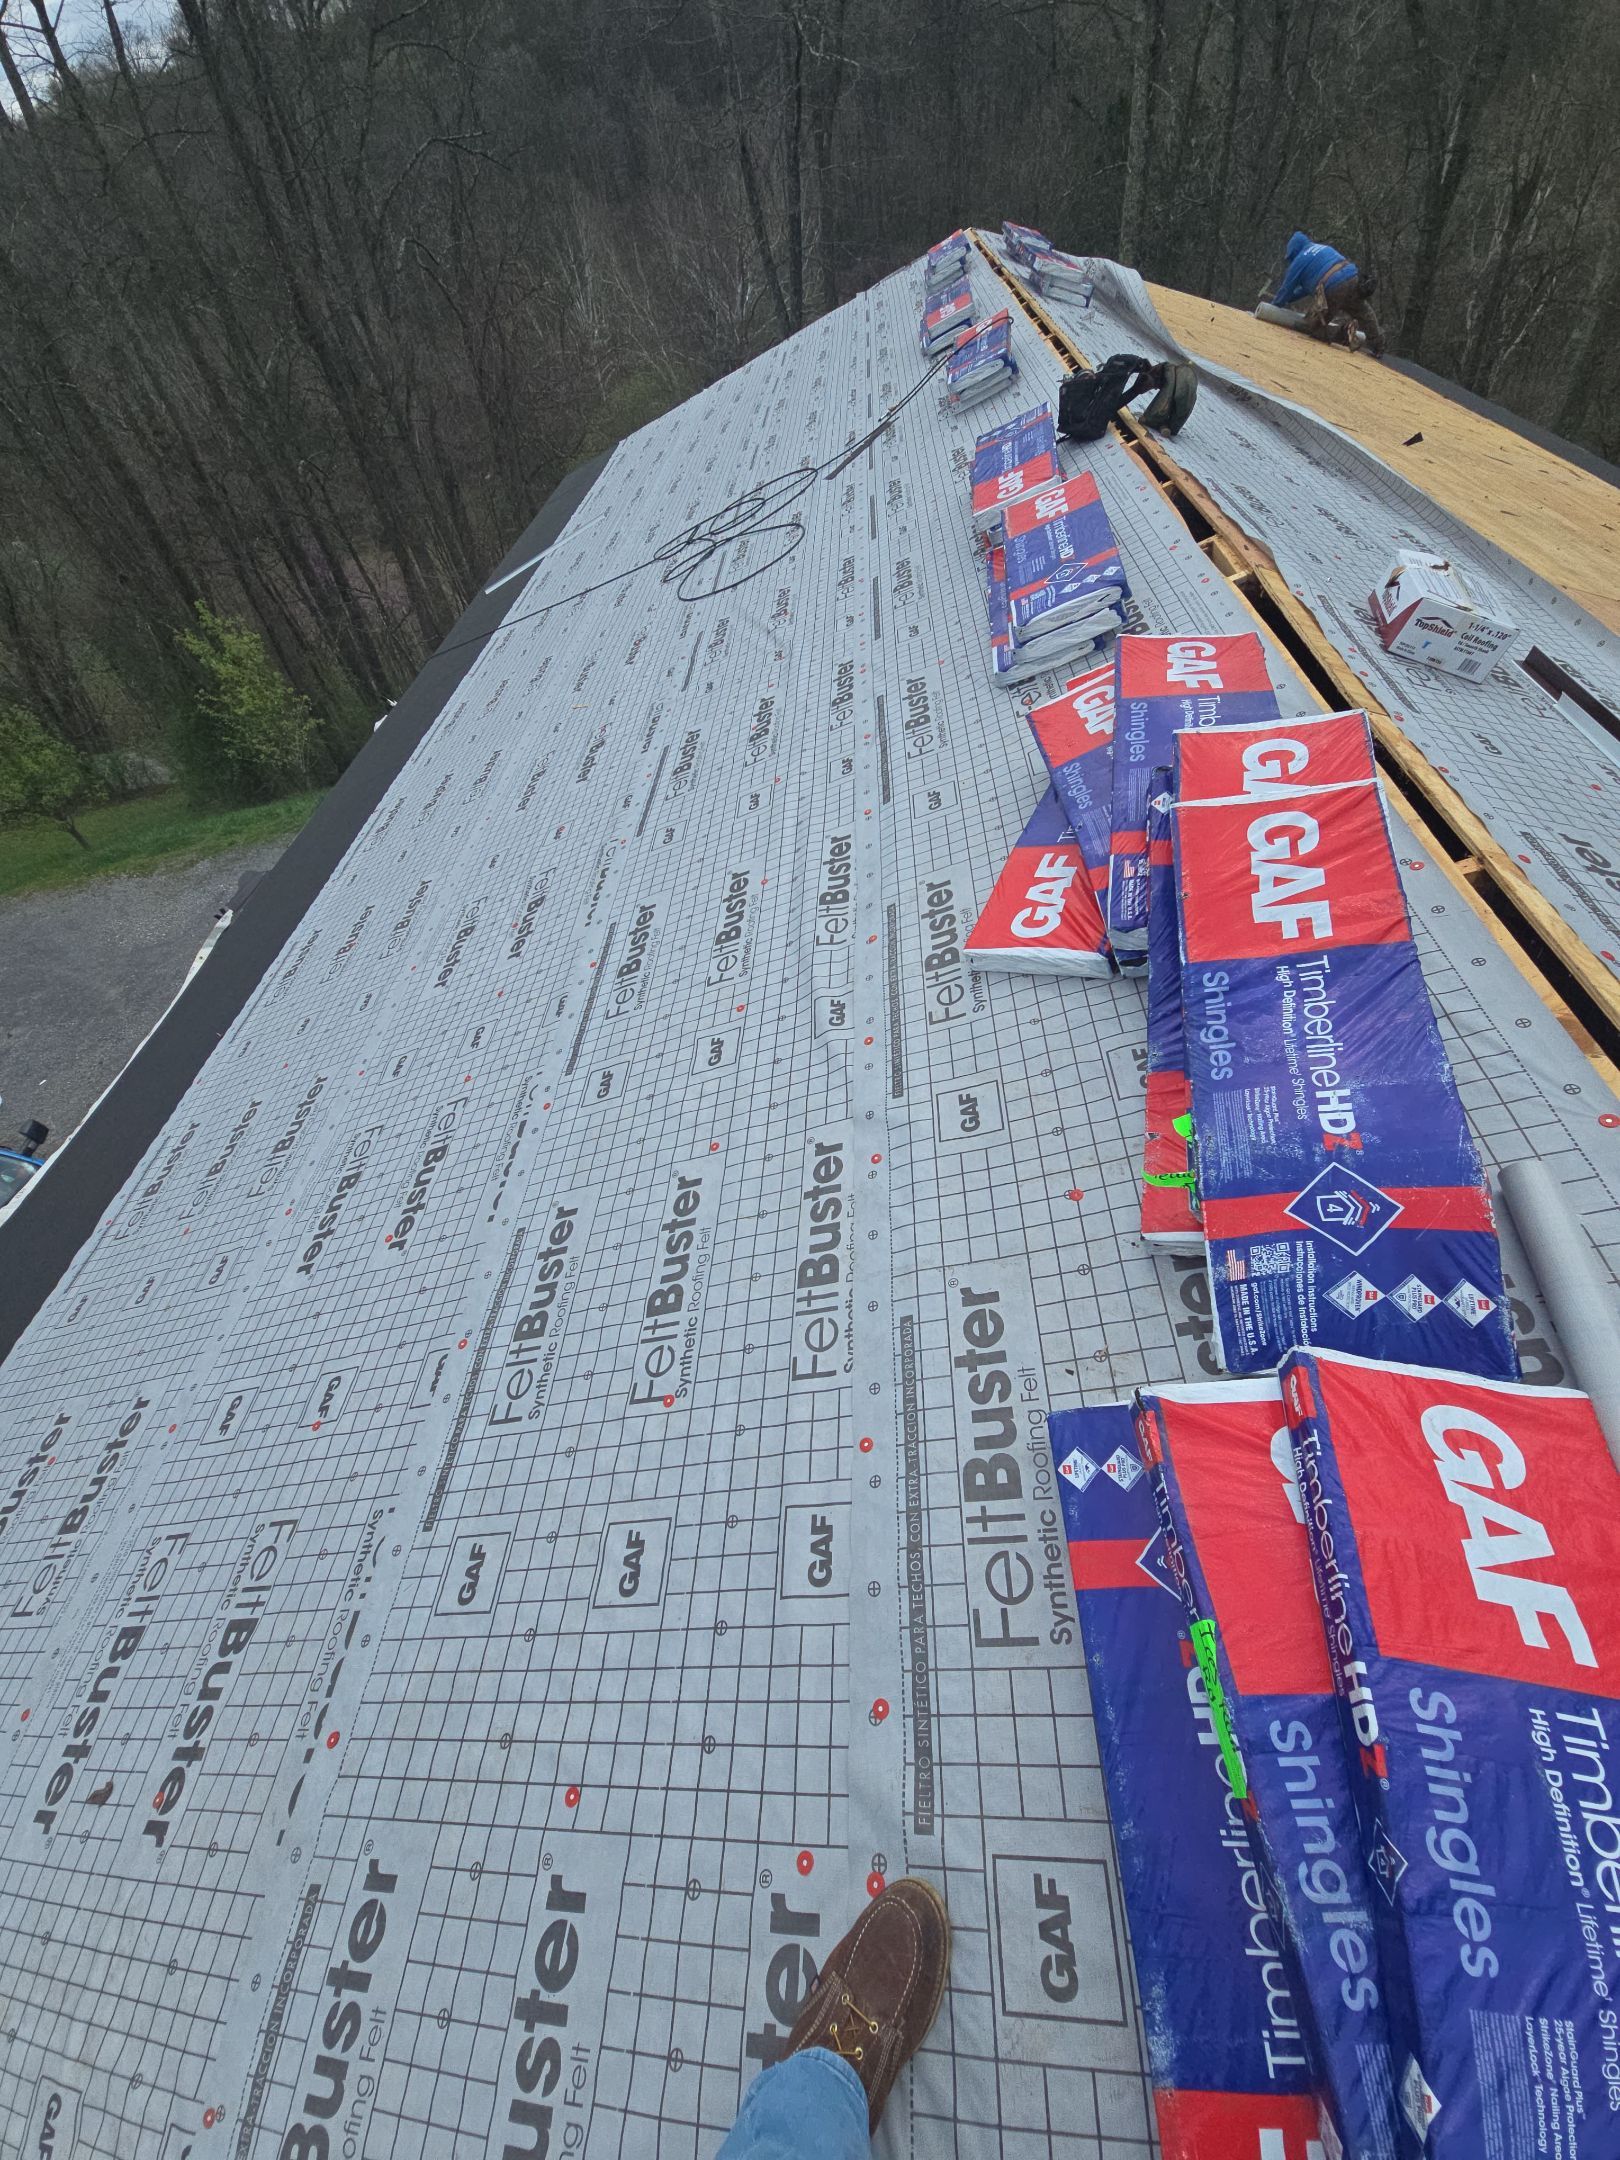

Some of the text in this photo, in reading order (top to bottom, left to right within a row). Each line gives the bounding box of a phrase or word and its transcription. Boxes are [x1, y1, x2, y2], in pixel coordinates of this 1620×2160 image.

[1035, 487, 1069, 520] GAF
[893, 557, 914, 610] FeltBuster
[908, 624, 919, 638] GAF
[1167, 641, 1224, 689] GAF
[1414, 618, 1454, 638] TopShield
[1461, 632, 1474, 643] Coil
[1473, 635, 1499, 652] Roofing
[745, 695, 776, 768] FeltBuster
[830, 659, 853, 732] FeltBuster
[902, 676, 935, 760] FeltBuster
[1125, 702, 1150, 762] Shingles
[665, 728, 703, 803] FeltBuster
[749, 792, 761, 811] GAF
[842, 757, 853, 776] GAF
[927, 790, 943, 811] GAF
[1062, 762, 1093, 811] Shingles
[663, 827, 675, 845] GAF
[814, 834, 852, 947] FeltBuster
[1010, 852, 1078, 939] GAF
[1246, 810, 1334, 940] GAF
[319, 904, 376, 985] FeltBuster
[378, 879, 433, 960] FeltBuster
[433, 895, 489, 989] FeltBuster
[507, 867, 557, 960] FeltBuster
[706, 869, 750, 988] FeltBuster
[605, 903, 657, 1021] FeltBuster
[920, 879, 966, 1027] FeltBuster
[828, 999, 847, 1028] GAF
[968, 970, 987, 1013] Syntheti
[1200, 971, 1236, 1081] Shingles
[392, 1055, 408, 1078] GAF
[470, 1026, 486, 1050] GAF
[708, 1036, 726, 1068] GAF
[1276, 966, 1308, 1121] High Definition Lifetime Shingles
[1296, 954, 1363, 1151] Timberline HDZ
[597, 1069, 615, 1100] GAF
[960, 1092, 981, 1133] GAF
[178, 1099, 263, 1222] FeltBuster
[247, 1074, 328, 1199] FeltBuster
[388, 1096, 468, 1251] FeltBuster
[114, 1121, 201, 1242] FeltBuster
[296, 1124, 385, 1276] FeltBuster
[134, 1276, 156, 1305] GAF
[208, 1255, 229, 1285] GAF
[629, 1174, 702, 1406] FeltBuster
[792, 1142, 844, 1382] FeltBuster
[1240, 1283, 1250, 1306] MADE
[1296, 1241, 1306, 1306] Instrucciones de
[1306, 1240, 1318, 1332] Installation Instructions
[67, 1295, 89, 1323] GAF
[488, 1205, 579, 1427] FeltBuster
[528, 1255, 581, 1421] Synthetic Roofing Felt
[674, 1225, 712, 1399] Synthetic Roofing Felt
[1242, 1306, 1251, 1316] IN
[1244, 1316, 1254, 1332] THE
[1247, 1332, 1259, 1356] U.S.A.
[317, 1375, 342, 1420] GAF
[902, 1319, 914, 1402] INCORPORADA
[217, 1394, 244, 1438] GAF
[954, 1287, 1040, 1648] FeltBuster
[1293, 1447, 1306, 1479] High
[10, 1396, 151, 1618] FeltBuster
[908, 1512, 920, 1544] CON
[1018, 1366, 1076, 1646] Synthetic Roofing Felt
[1299, 1481, 1317, 1552] Definition
[1420, 1404, 1600, 1669] GAF
[36, 1538, 82, 1617] Synthetic
[114, 1535, 162, 1620] Synthetic
[456, 1542, 487, 1606] GAF
[618, 1529, 646, 1598] GAF
[808, 1513, 834, 1588] GAF
[166, 1523, 265, 1739] Synthetic Roofing Felt
[294, 1508, 384, 1740] Synthetic Roofing Felt
[910, 1613, 926, 1655] PARA
[1302, 1429, 1389, 1779] Timberline HDZ
[33, 1532, 191, 1836] FeltBuster
[75, 1625, 119, 1699] Roofing
[142, 1518, 299, 1848] FeltBuster
[1326, 1623, 1345, 1697] Shingles
[57, 1703, 81, 1739] Felt
[913, 1660, 929, 1748] SINTÉTICO
[918, 1758, 931, 1826] FIELTRO
[1269, 1719, 1379, 2012] Shingles
[1408, 1687, 1499, 1979] Shingles
[1033, 1873, 1080, 2004] GAF
[1528, 1707, 1620, 2112] High Definition Lifetime Shingles
[273, 1893, 321, 2018] INCORPORADA
[279, 1858, 398, 2160] Buster
[359, 2005, 387, 2063] Felt
[1554, 2019, 1568, 2066] 25-year
[563, 2041, 591, 2108] Felt
[1539, 2017, 1555, 2080] StrikeZone
[1549, 2087, 1561, 2130] Nailing
[1559, 2066, 1572, 2103] Algae
[1565, 2019, 1585, 2114] StainGuard Plus
[1534, 2083, 1549, 2154] Technology
